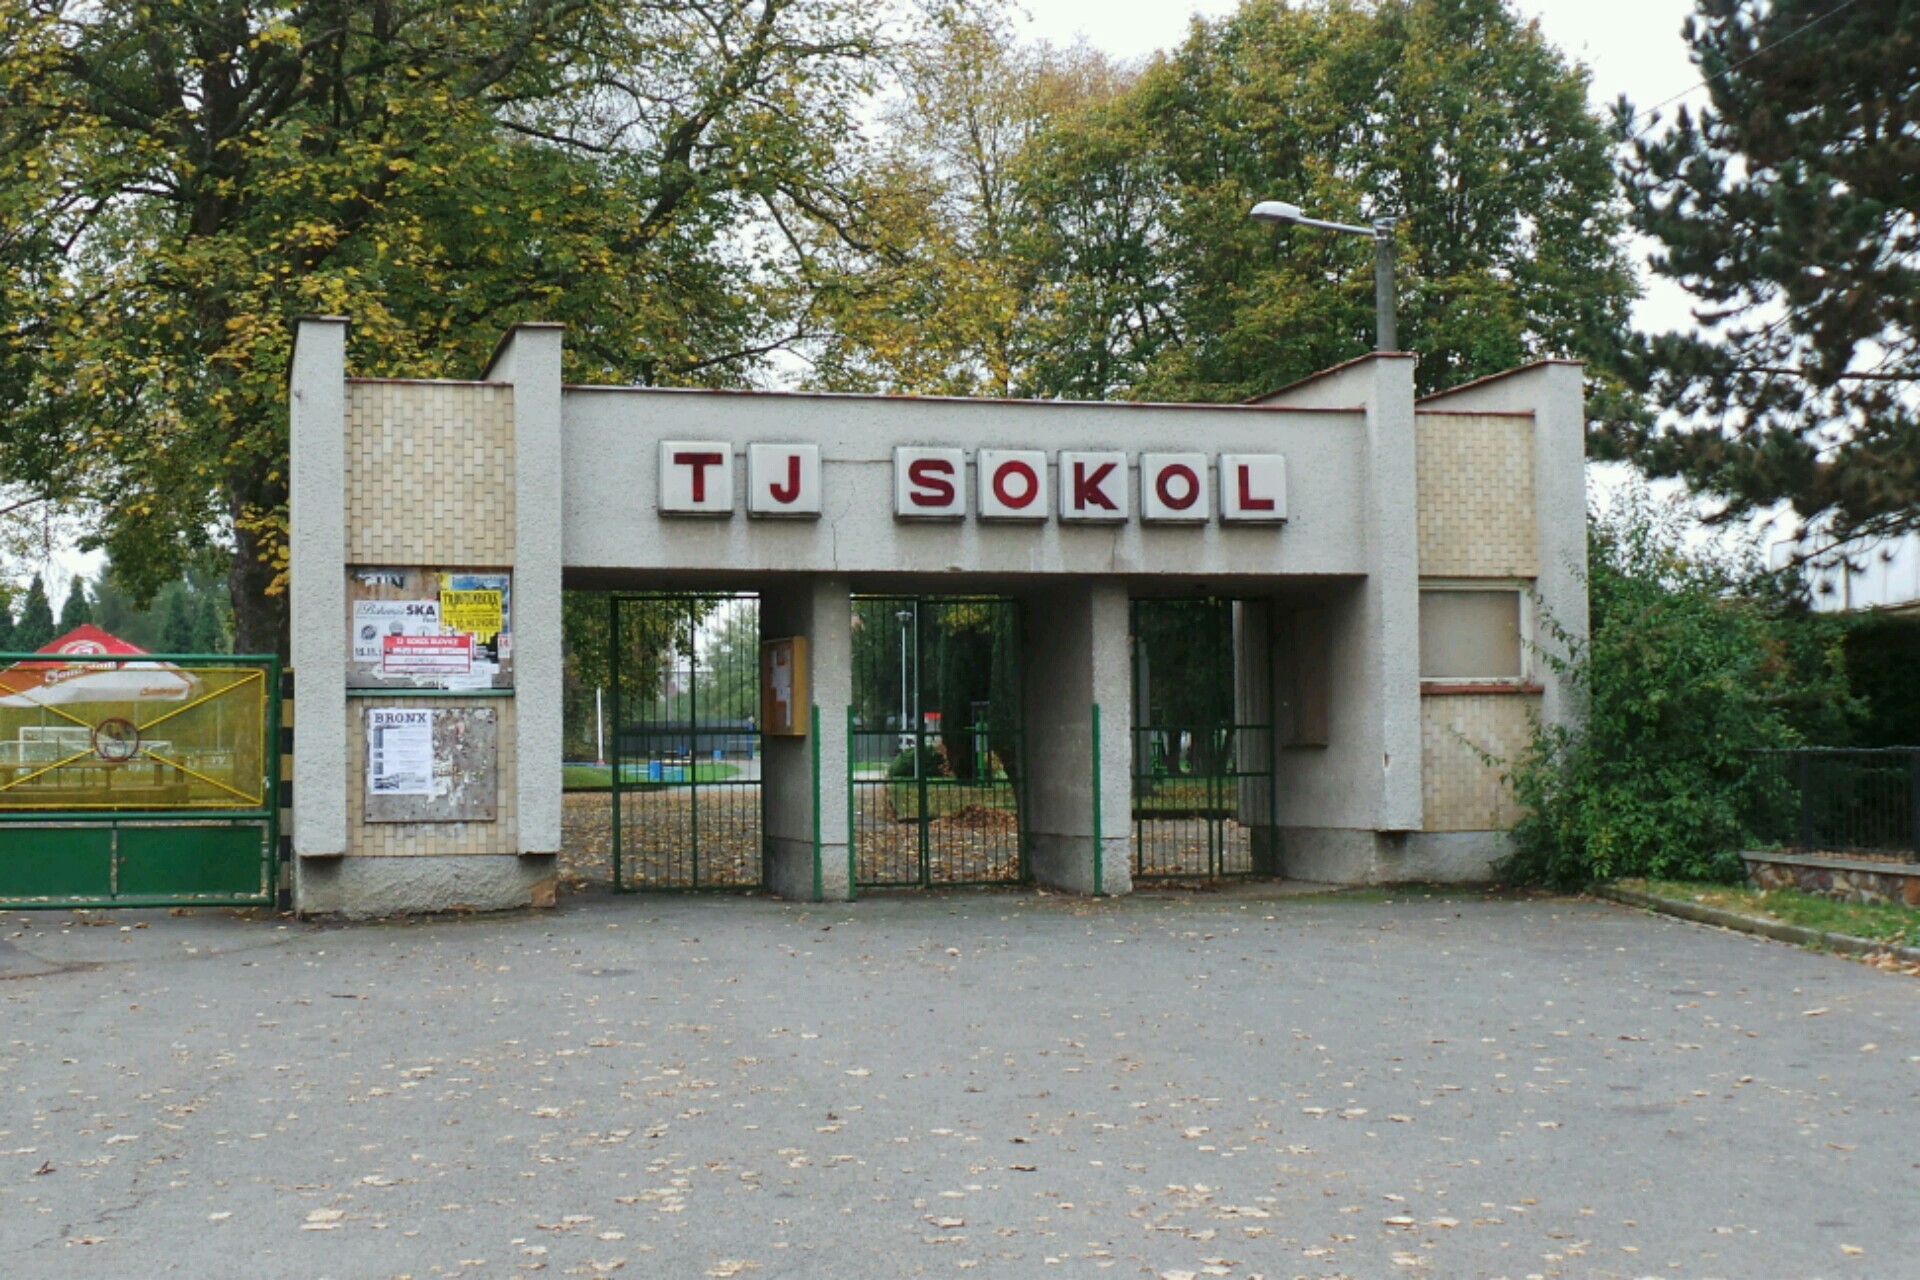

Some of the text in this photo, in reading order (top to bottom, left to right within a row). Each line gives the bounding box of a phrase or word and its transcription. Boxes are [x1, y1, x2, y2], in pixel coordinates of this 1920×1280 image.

[673, 452, 1276, 511] TJ SOKOL
[406, 604, 435, 615] SKA
[374, 712, 427, 724] BRONX
